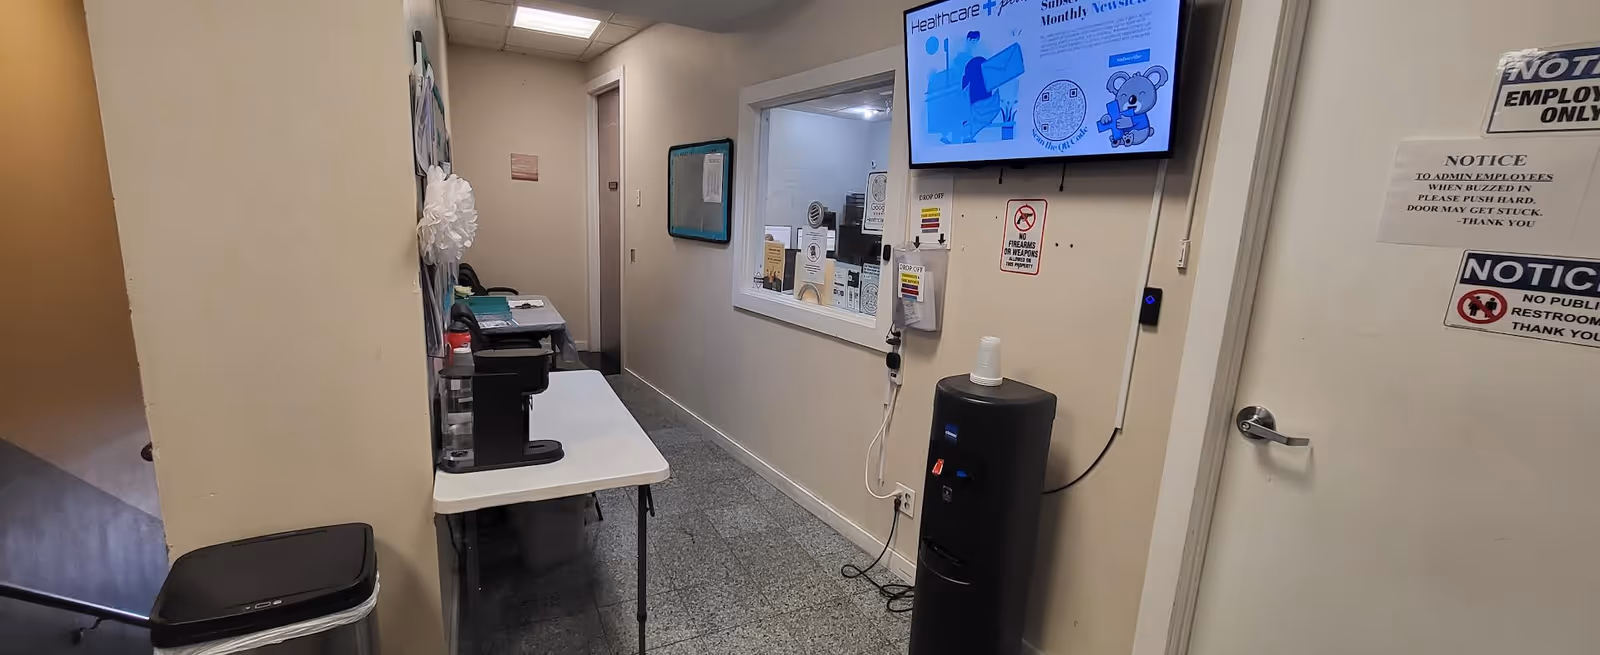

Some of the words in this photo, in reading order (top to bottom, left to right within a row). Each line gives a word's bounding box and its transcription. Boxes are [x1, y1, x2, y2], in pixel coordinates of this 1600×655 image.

[910, 4, 980, 34] Healthcare
[1041, 5, 1088, 27] Monthly
[1058, 141, 1070, 153] QR
[1071, 126, 1088, 145] Code
[1444, 154, 1528, 167] NOTICE
[1414, 172, 1431, 181] TO
[1433, 173, 1473, 181] ADMIN
[1475, 173, 1554, 182] EMPLOYEES
[1428, 183, 1463, 191] WHEN
[1465, 184, 1515, 192] BUZZED
[934, 192, 945, 200] OFF
[1418, 194, 1461, 203] PLEASE
[1463, 195, 1494, 203] PUSH
[1496, 196, 1537, 205] HARD.
[1407, 204, 1439, 212] DOOR
[1441, 205, 1467, 214] MAY
[1469, 206, 1495, 215] GET
[1496, 207, 1543, 217] STUCK.
[1457, 217, 1505, 227] -THANK
[1508, 219, 1537, 228] YOU
[1018, 232, 1027, 240] NO
[1008, 240, 1037, 250] FIREARMS
[1004, 247, 1012, 255] OR
[1013, 249, 1039, 259] WEAPONS
[899, 263, 913, 271] DROP
[1522, 293, 1546, 304] NO
[1512, 321, 1565, 337] THANK
